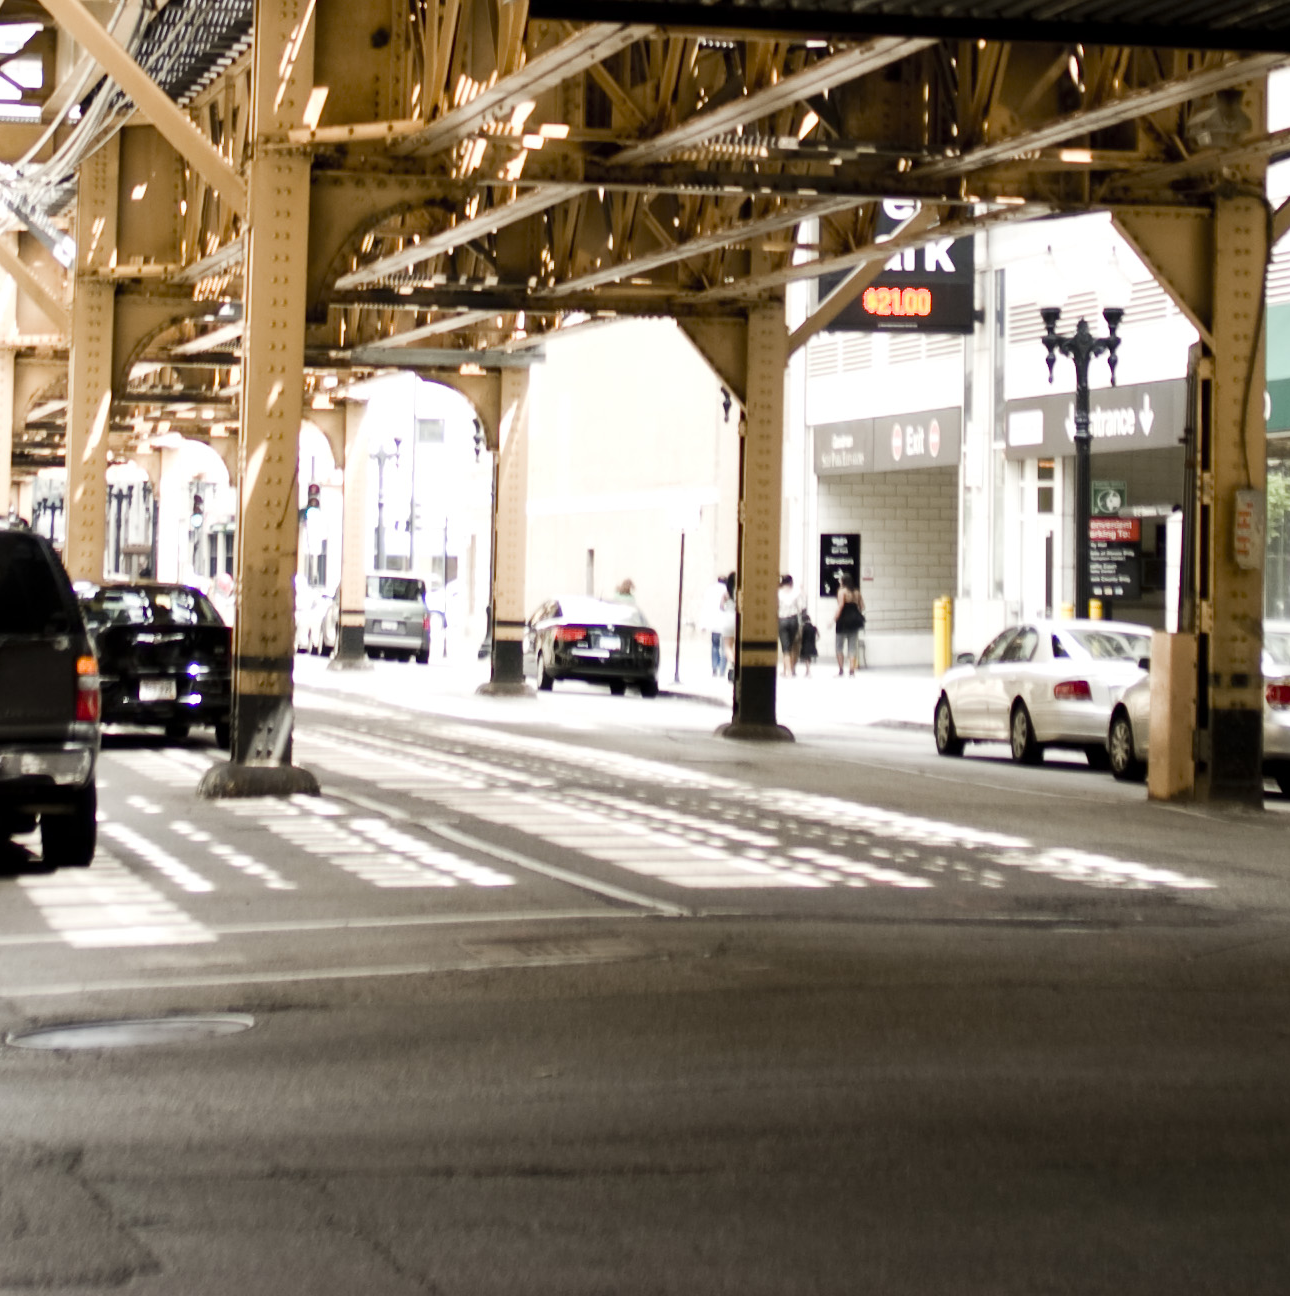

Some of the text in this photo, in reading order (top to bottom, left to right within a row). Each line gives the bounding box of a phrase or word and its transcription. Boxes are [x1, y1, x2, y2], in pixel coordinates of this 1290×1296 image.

[881, 237, 957, 272] ark
[863, 287, 932, 316] $21.00
[1089, 404, 1136, 437] ntrance
[905, 424, 925, 456] Exit
[1090, 520, 1132, 530] onvenient
